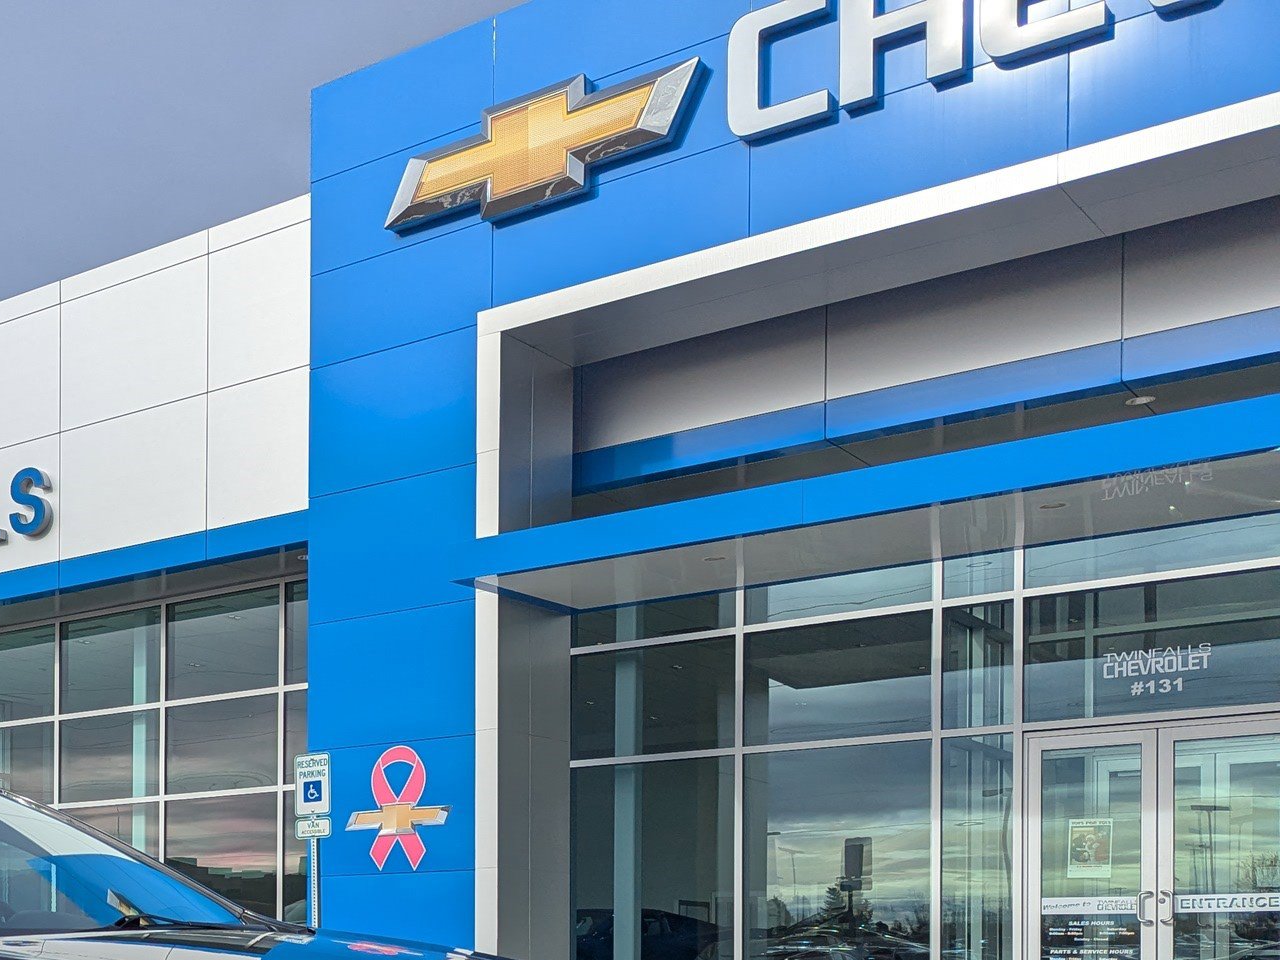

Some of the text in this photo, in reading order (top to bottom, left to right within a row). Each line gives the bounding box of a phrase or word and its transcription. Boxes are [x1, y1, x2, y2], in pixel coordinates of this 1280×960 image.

[1102, 642, 1212, 662] TWINFALLS
[1103, 652, 1212, 679] CHEVROLET
[1130, 677, 1183, 696] #131
[297, 758, 328, 769] RESERVED
[299, 769, 326, 779] PARKING
[307, 821, 320, 829] VAN
[1180, 896, 1280, 909] ENTRANCE
